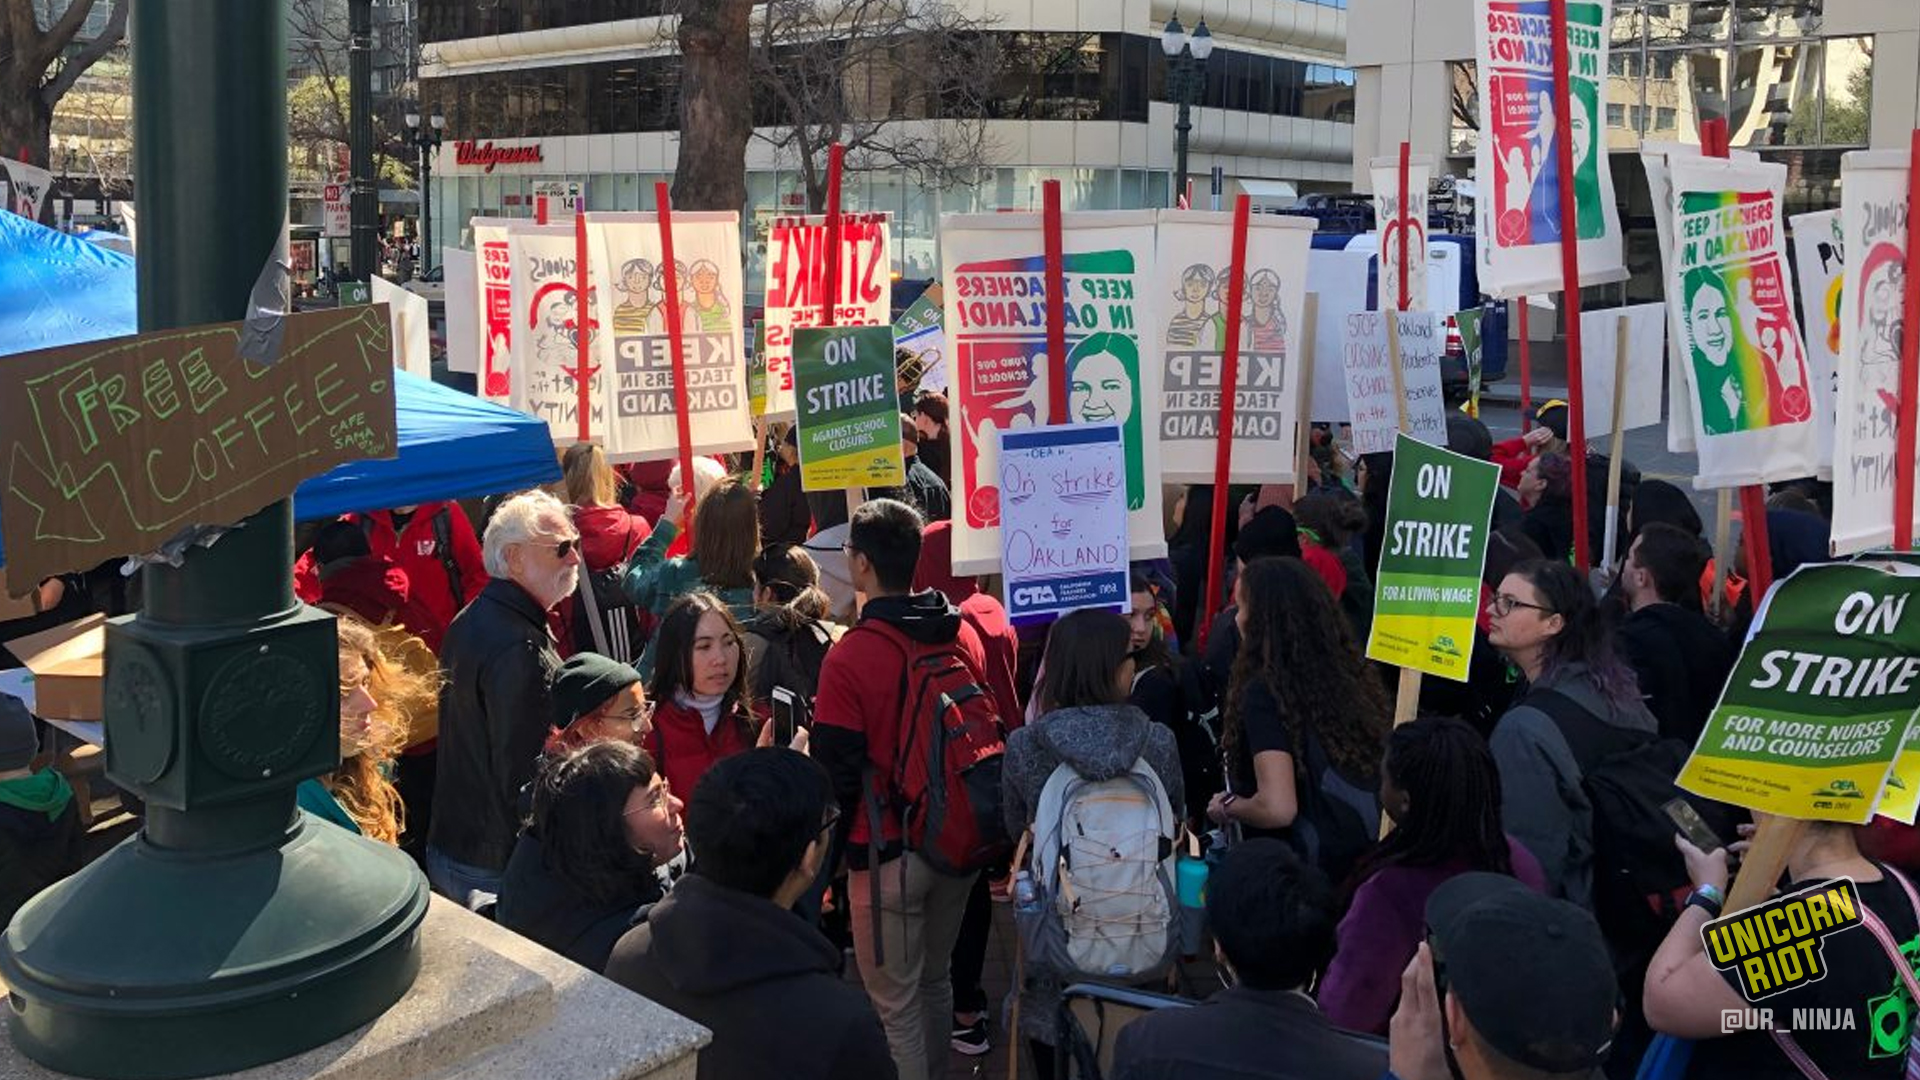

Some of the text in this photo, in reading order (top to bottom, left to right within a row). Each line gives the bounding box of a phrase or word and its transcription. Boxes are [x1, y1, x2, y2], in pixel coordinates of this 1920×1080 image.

[455, 139, 543, 174] Walgreens
[326, 187, 338, 199] NO
[563, 198, 574, 209] 14
[1347, 313, 1378, 338] STOP
[824, 336, 857, 366] ON
[58, 347, 228, 454] FREE
[806, 373, 885, 414] STRIKE
[329, 412, 365, 438] CAFE
[813, 418, 888, 443] AGAINST SCHOOL
[829, 432, 875, 452] CLOSURES
[1003, 463, 1122, 495] On strike
[1416, 463, 1452, 499] ON
[1051, 513, 1073, 530] for
[1006, 529, 1118, 573] OAKLAND
[1391, 520, 1473, 560] STRIKE
[1099, 583, 1118, 595] nea
[1383, 585, 1474, 603] FOR A LIVING WAGE
[1834, 591, 1911, 635] ON
[1750, 650, 1920, 697] STRIKE
[1724, 715, 1765, 733] FOR
[1766, 719, 1827, 741] MORE
[1828, 719, 1895, 741] NURSES
[1722, 734, 1885, 760] AND COUNSELORS
